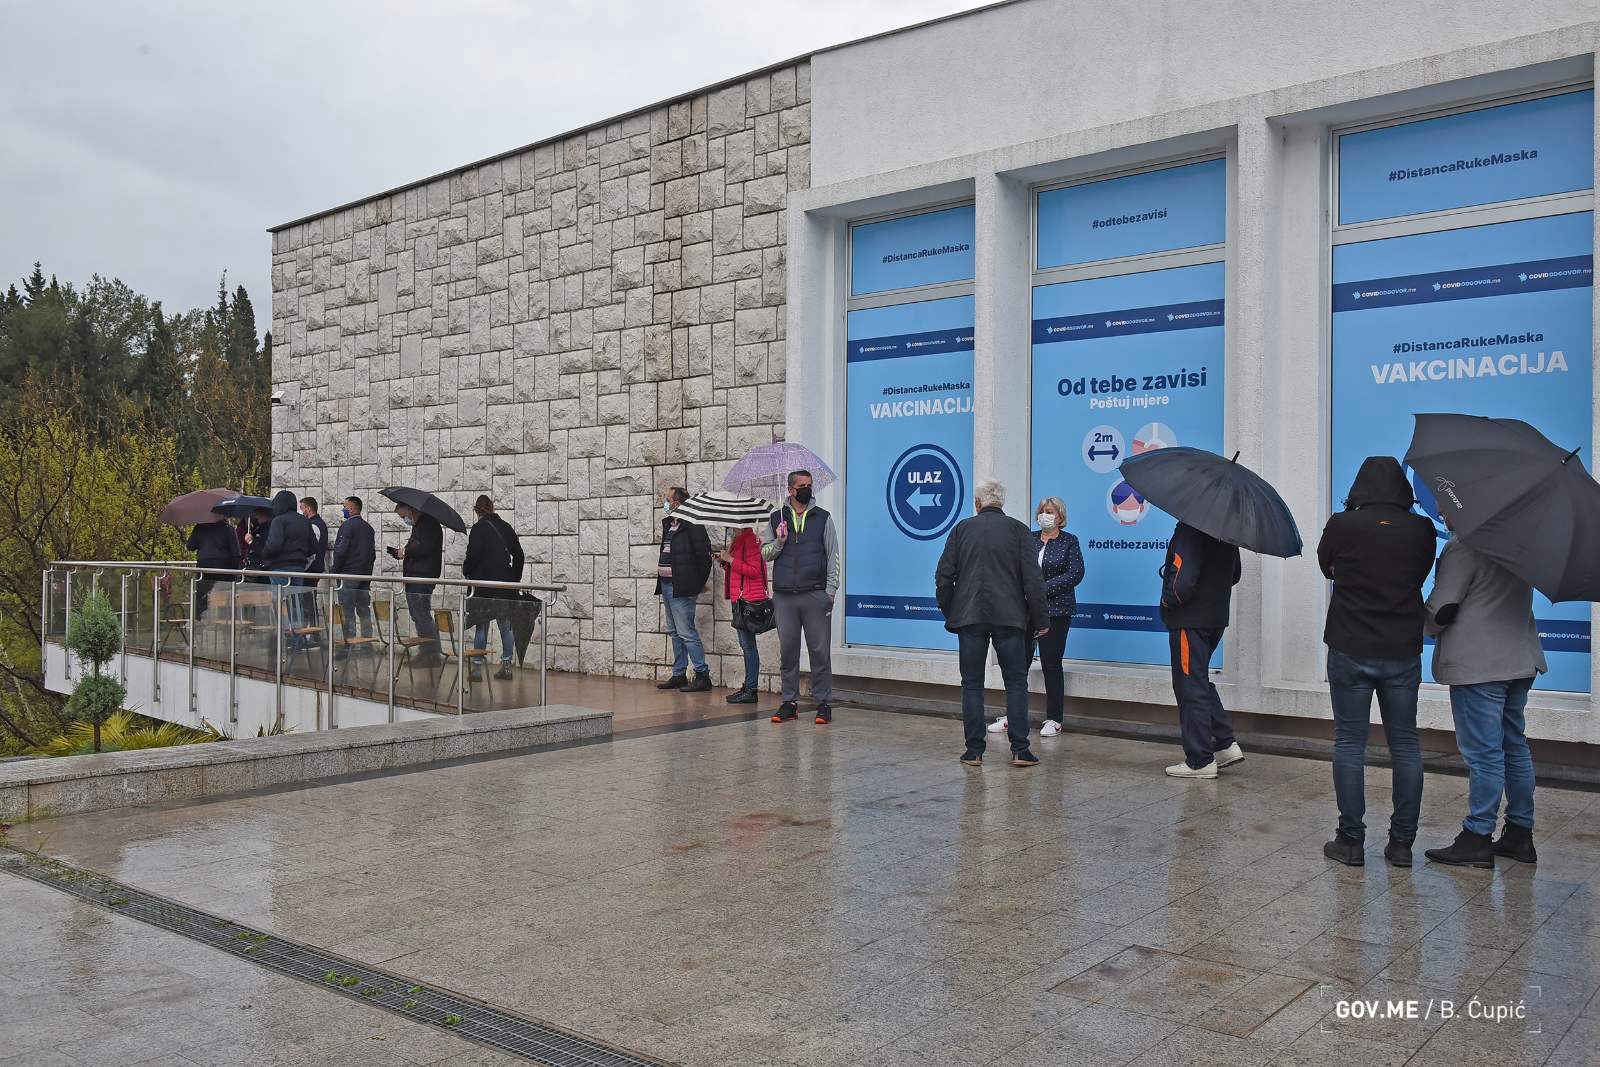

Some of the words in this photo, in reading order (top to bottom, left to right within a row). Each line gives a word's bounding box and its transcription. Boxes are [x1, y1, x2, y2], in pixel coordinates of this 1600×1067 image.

[1388, 149, 1538, 181] #DistancaRukeMaska
[1092, 208, 1168, 229] #odtebezavisi
[882, 243, 970, 264] #DistancaRukeMaska
[1392, 332, 1544, 353] #DistancaRukeMaska
[1370, 350, 1569, 384] VAKCINACIJA
[883, 381, 970, 396] #DistancaRukeMaska
[1057, 377, 1085, 396] Od
[1089, 374, 1137, 394] tebe
[1142, 367, 1207, 391] zavisi
[1090, 396, 1130, 410] Poštuj
[1132, 395, 1169, 409] mjere
[1094, 432, 1113, 443] 2m
[907, 471, 942, 484] ULAZ
[1088, 538, 1169, 550] #odtebezavisi
